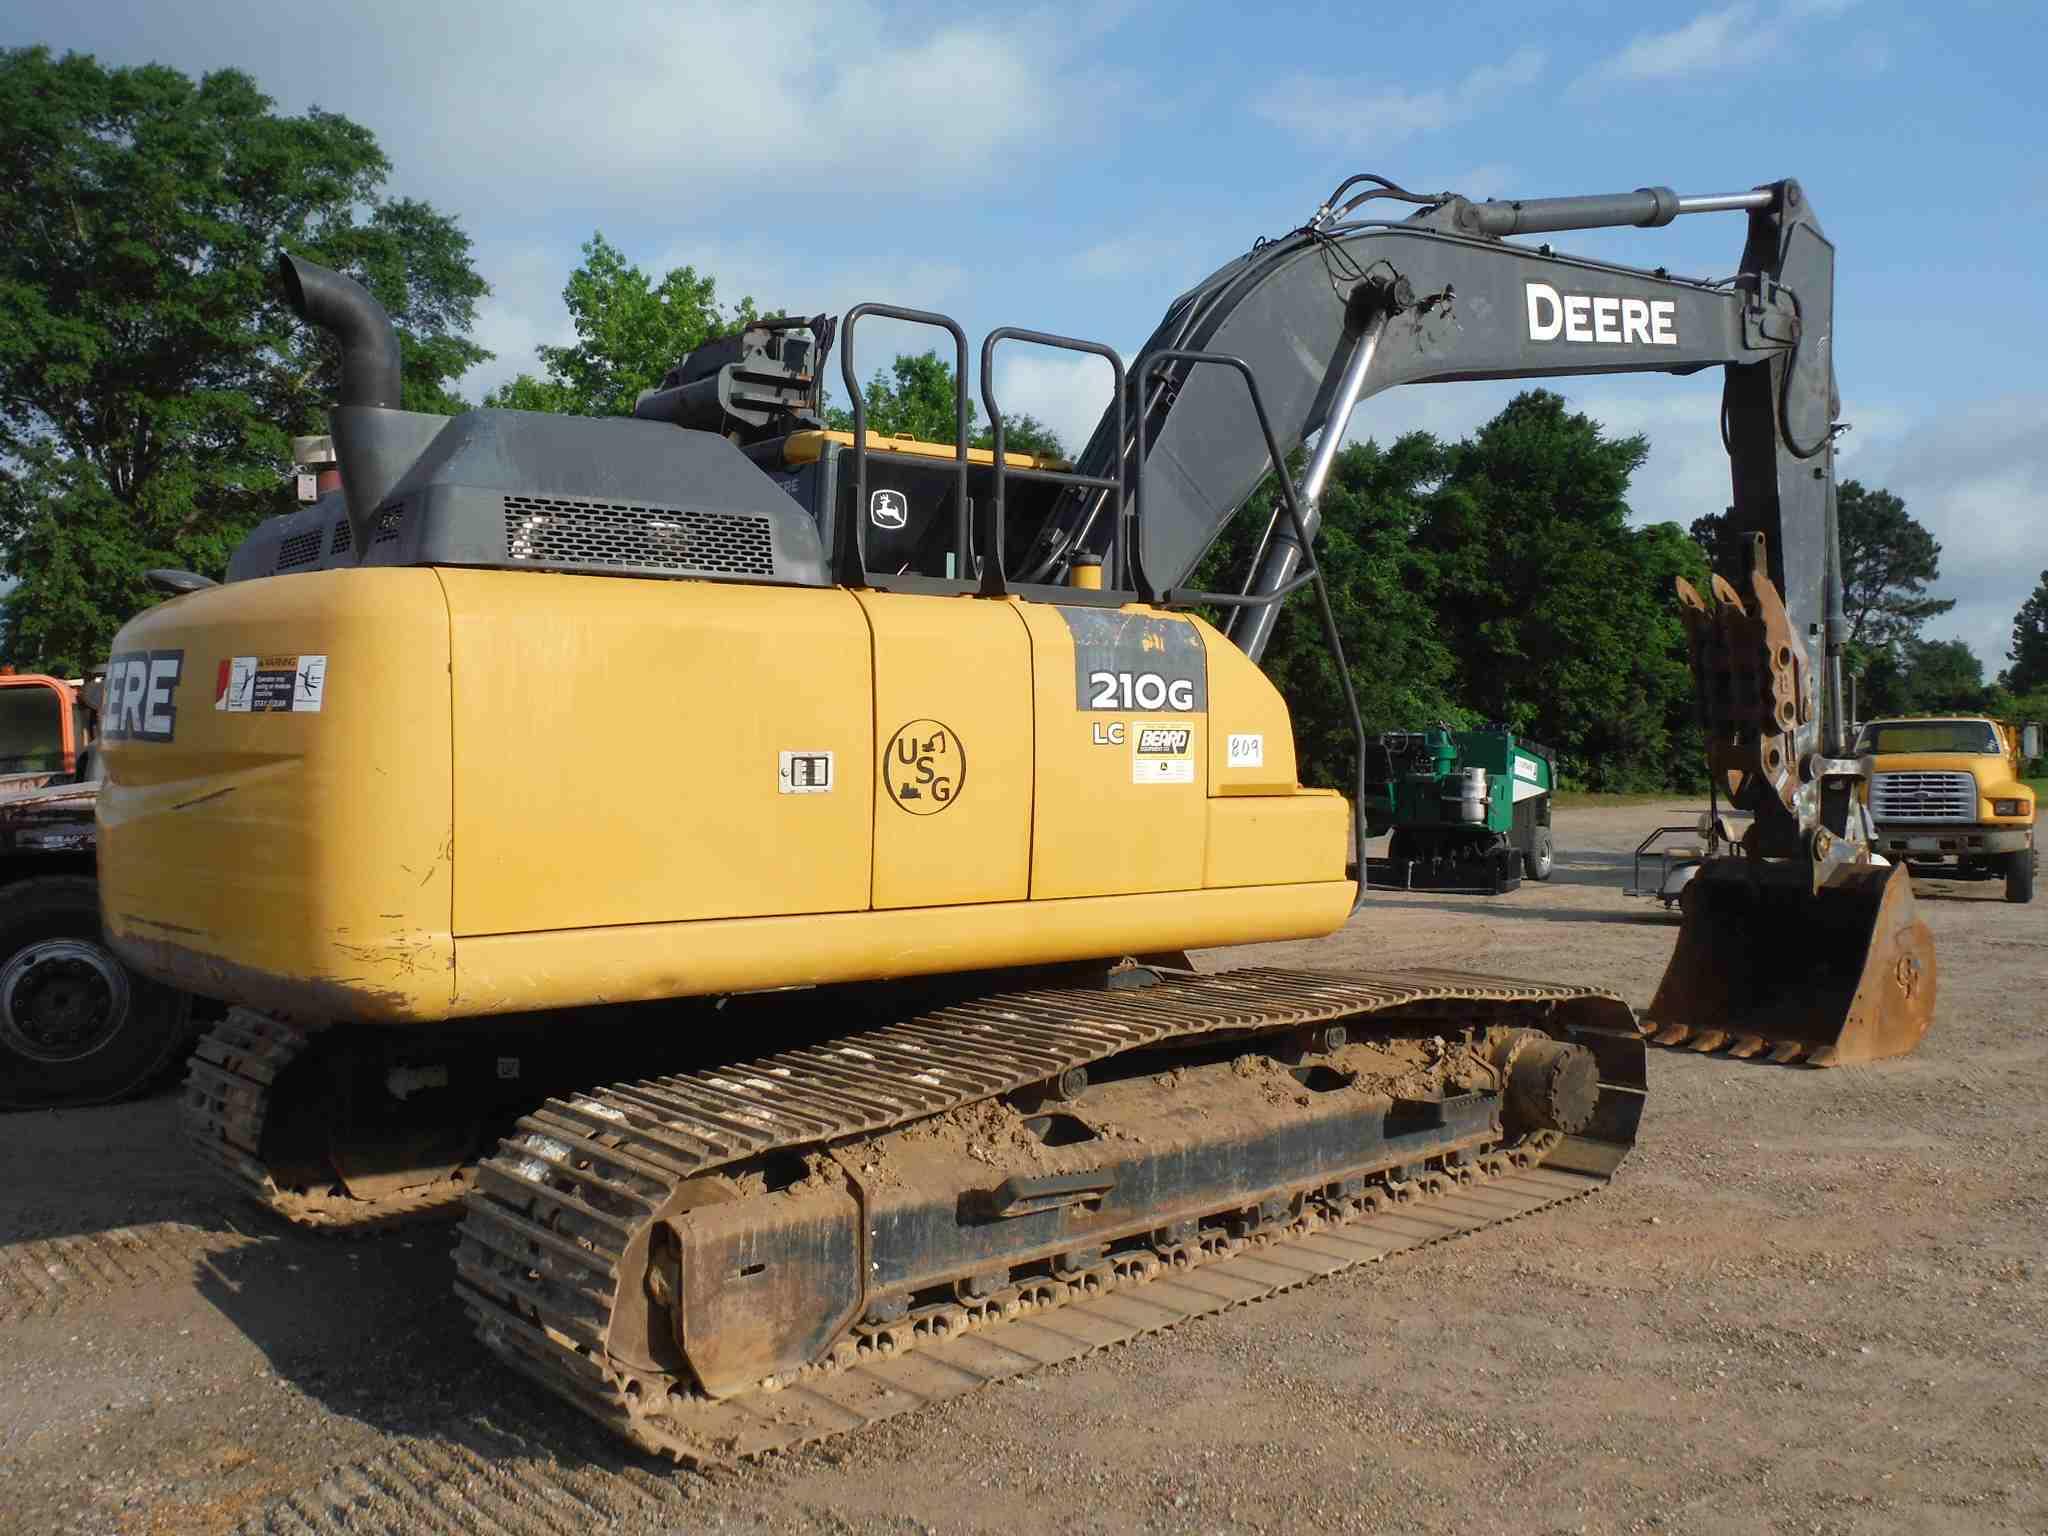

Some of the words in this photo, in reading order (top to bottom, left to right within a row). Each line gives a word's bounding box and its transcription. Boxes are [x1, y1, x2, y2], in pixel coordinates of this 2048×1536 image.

[1525, 282, 1677, 345] DEERE
[1090, 672, 1193, 711] 210G
[1093, 722, 1124, 745] LC
[1140, 730, 1186, 747] BEARD
